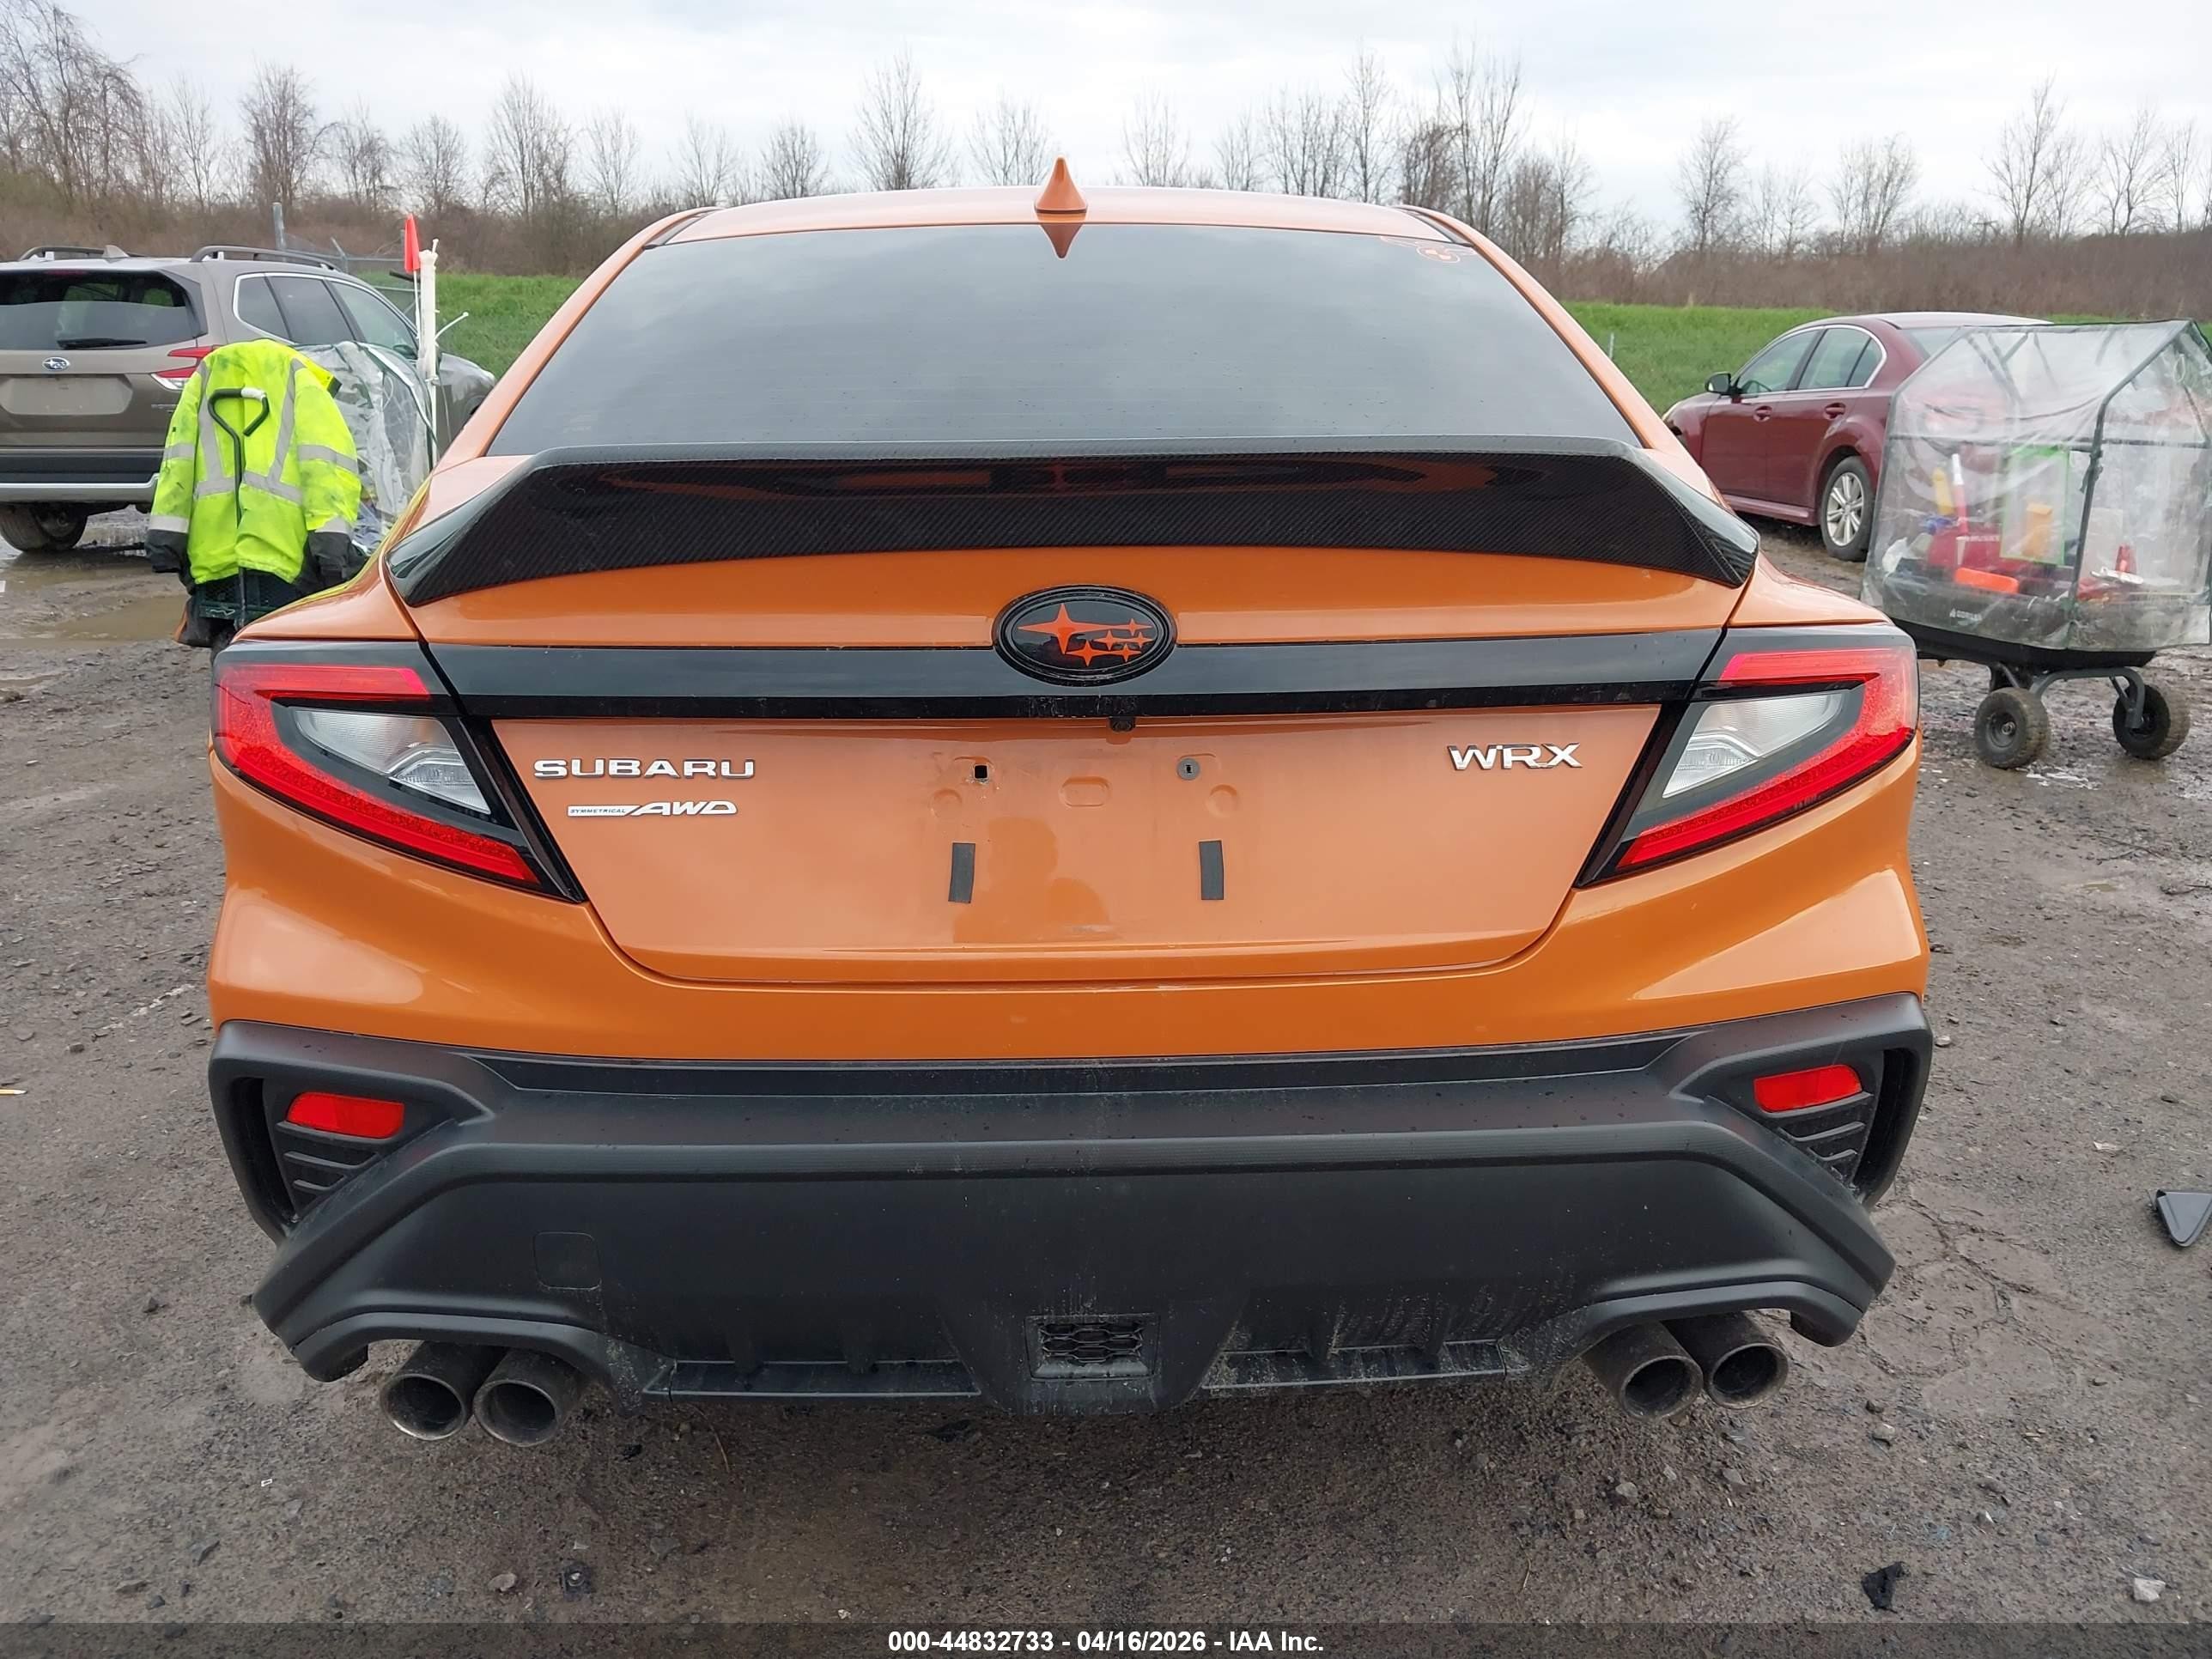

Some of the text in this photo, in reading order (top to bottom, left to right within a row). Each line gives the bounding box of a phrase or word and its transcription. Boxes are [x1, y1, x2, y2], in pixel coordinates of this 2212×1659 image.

[1448, 742, 1583, 770] WRX
[533, 758, 755, 779] SUBARU
[628, 800, 738, 816] AWD
